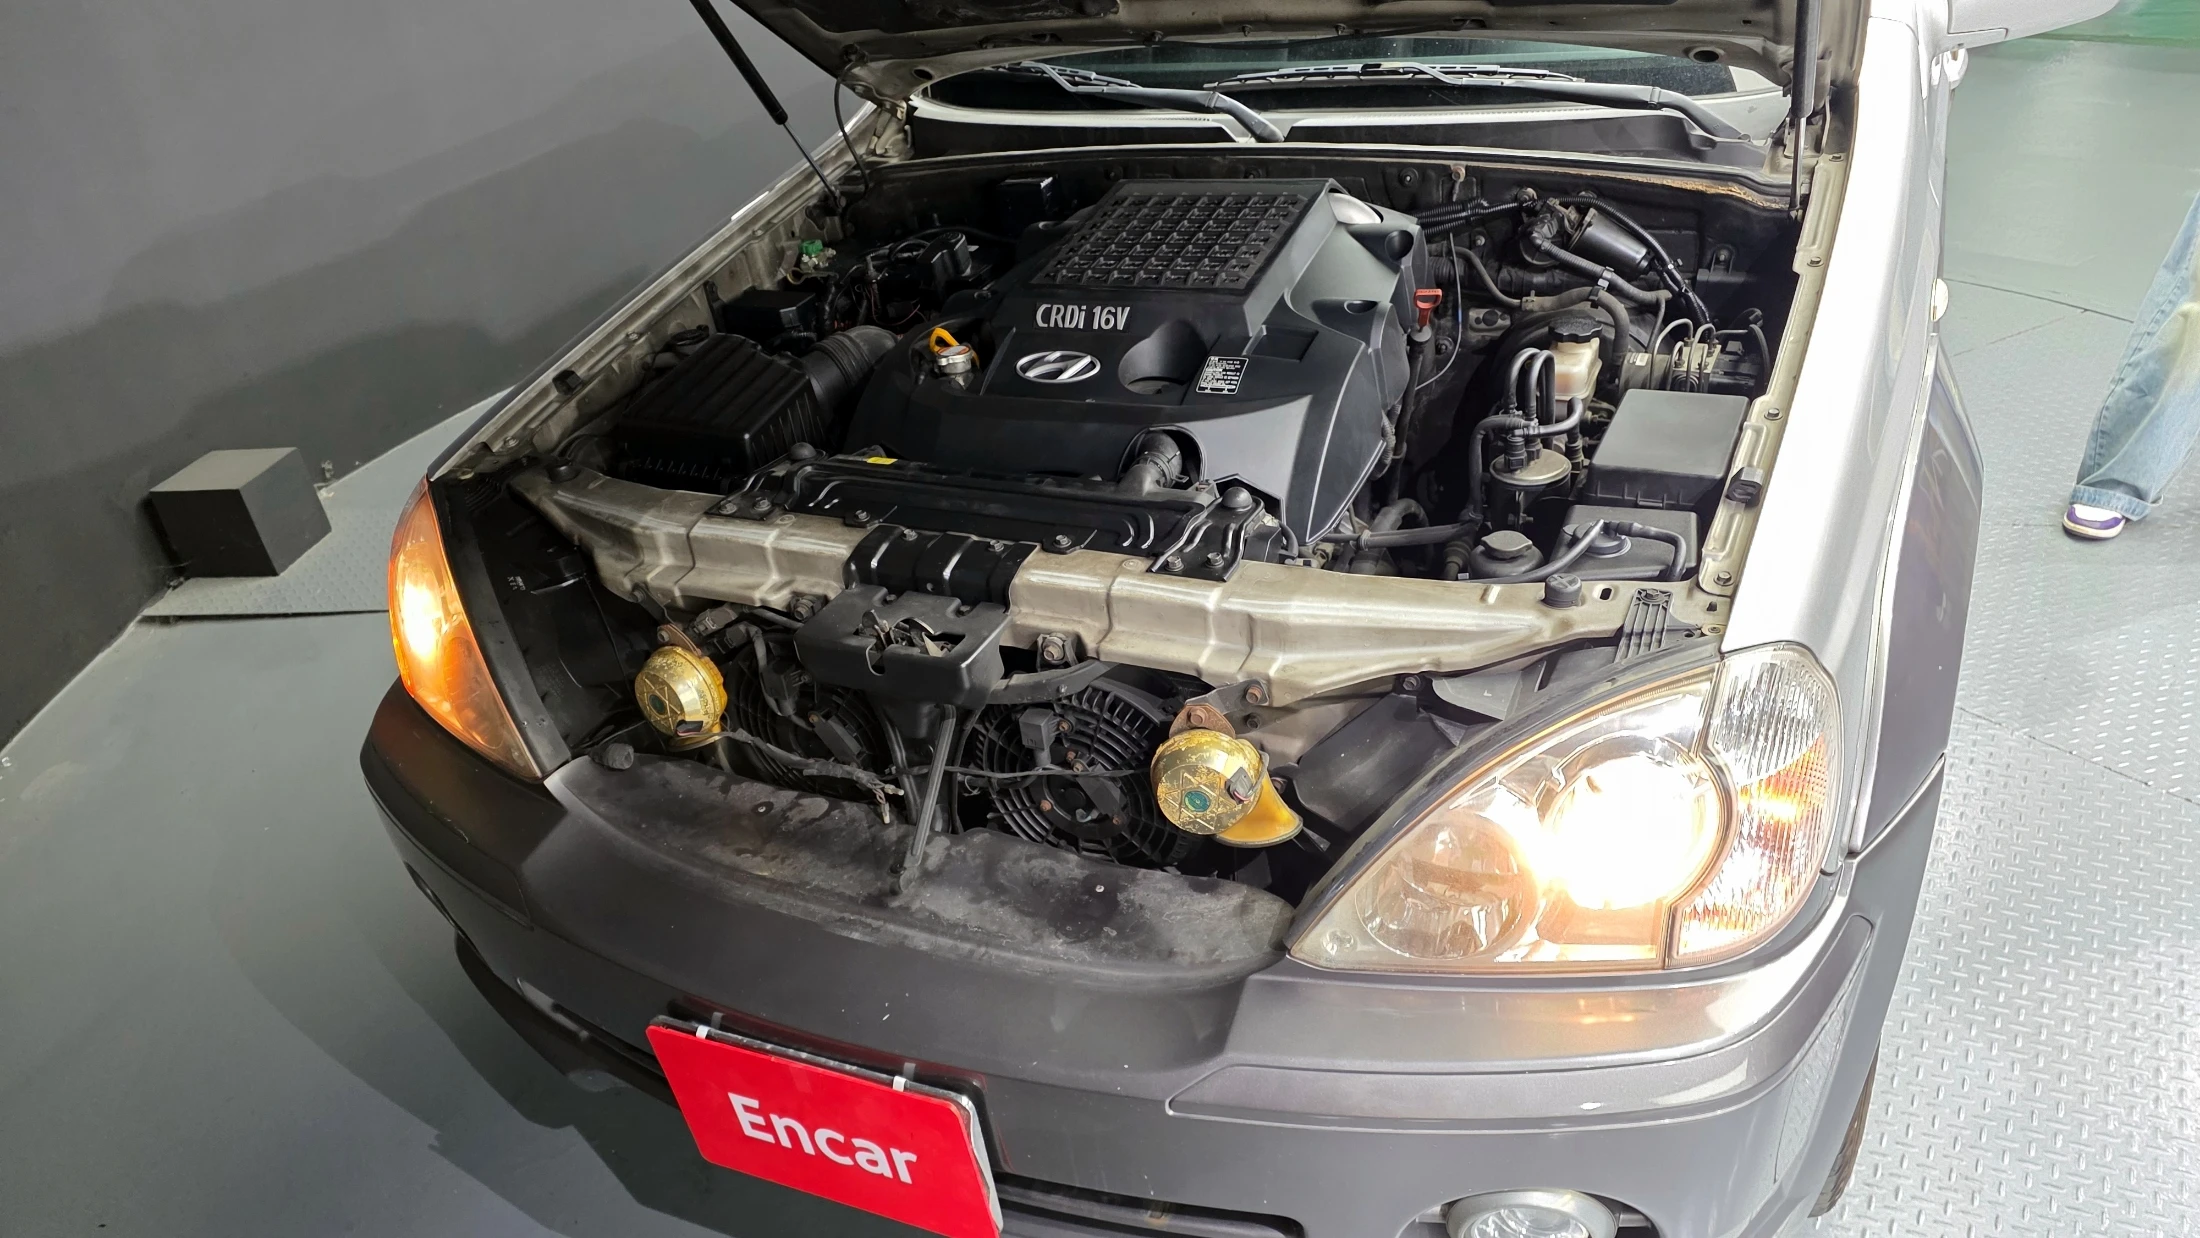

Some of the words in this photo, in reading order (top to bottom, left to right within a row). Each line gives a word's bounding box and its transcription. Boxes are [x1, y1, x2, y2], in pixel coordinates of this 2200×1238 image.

[1036, 304, 1087, 329] CRDi
[1092, 305, 1131, 330] 16V
[727, 1092, 918, 1184] Encar
